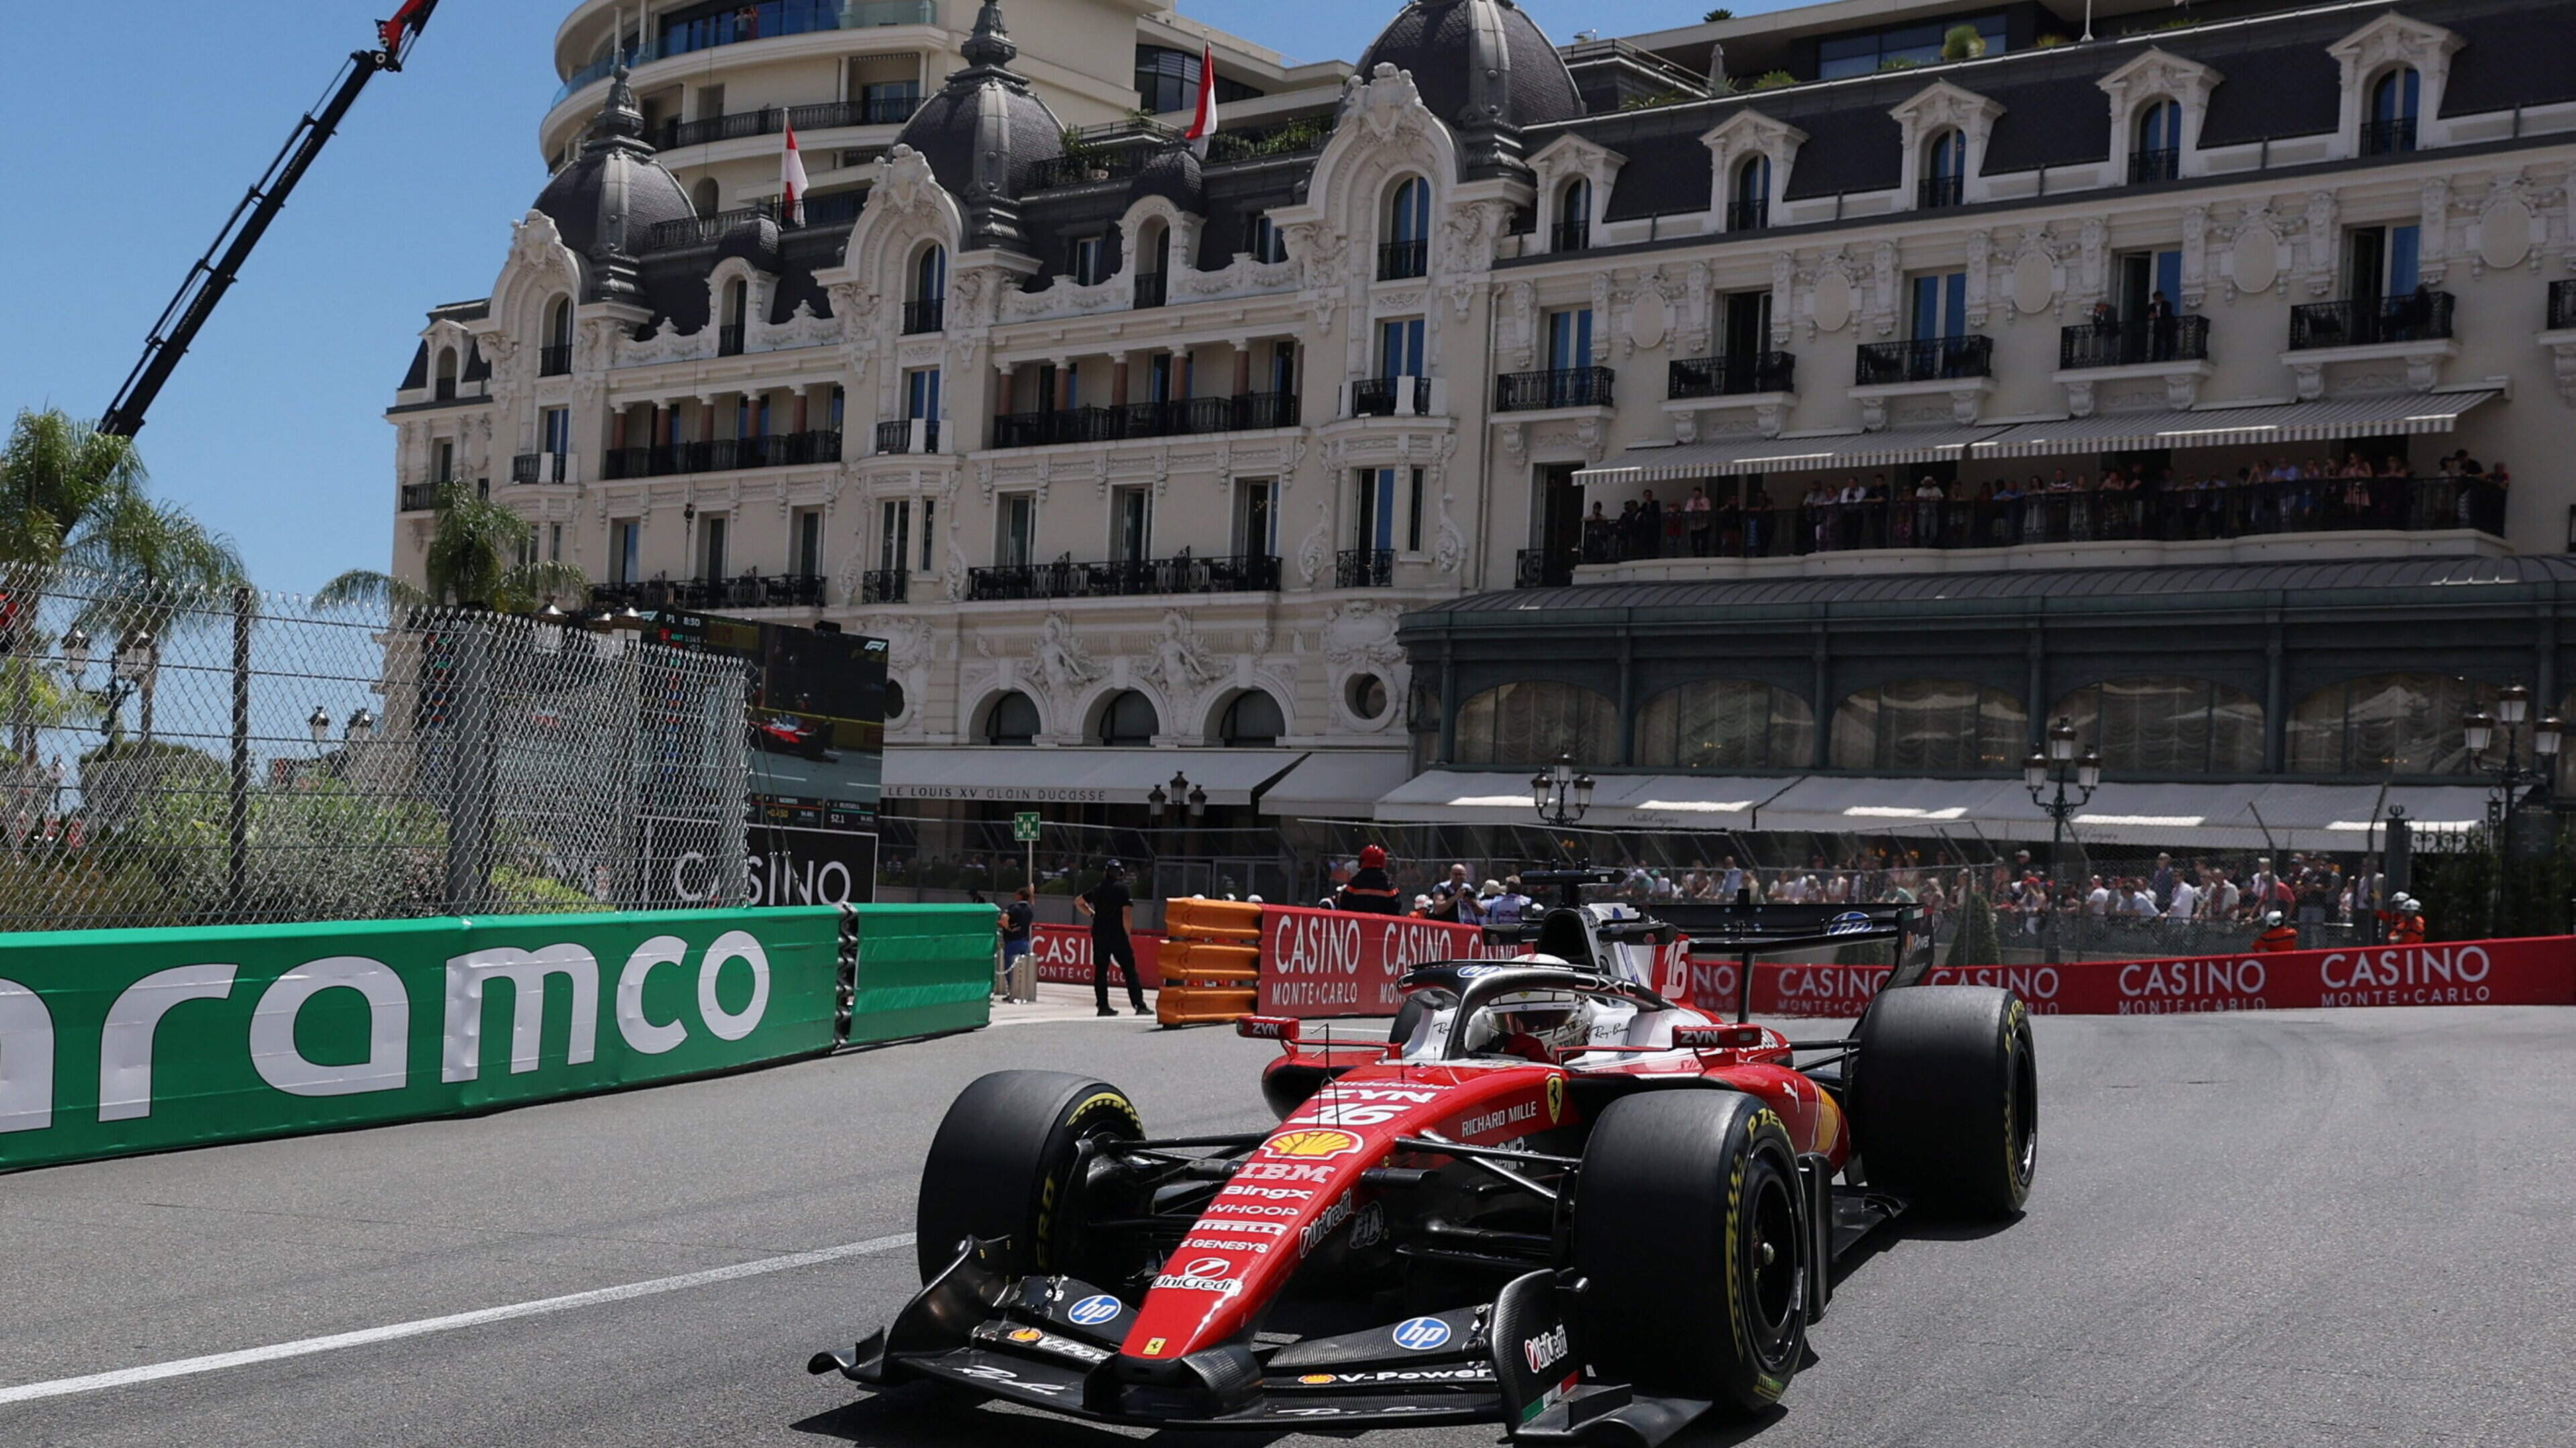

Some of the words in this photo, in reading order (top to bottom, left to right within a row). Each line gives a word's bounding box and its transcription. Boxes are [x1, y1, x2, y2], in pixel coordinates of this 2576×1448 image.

[888, 787, 903, 796] LE
[911, 787, 951, 797] LOUIS
[960, 789, 977, 797] XV
[1031, 936, 1121, 967] CASI
[1276, 914, 1360, 974] CASINO
[1383, 922, 1451, 975] CASINO
[1039, 966, 1073, 979] ONTE
[1662, 940, 1689, 999] 16
[2118, 960, 2265, 996] CASINO
[2321, 946, 2489, 989] CASINO
[1272, 983, 1313, 1005] MONTE
[1321, 982, 1358, 1004] CARLO
[1575, 974, 1637, 998] DXC
[2322, 990, 2397, 1007] MONTE
[2415, 986, 2489, 1003] CARLO
[1252, 1023, 1279, 1036] ZYN
[1680, 1031, 1718, 1044] ZYN
[1309, 1089, 1437, 1103] ZYN
[1287, 1103, 1412, 1125] 16
[1462, 1110, 1506, 1137] RICHARD
[1509, 1101, 1537, 1123] MILLE
[1234, 1163, 1336, 1184] IBM
[1208, 1205, 1299, 1216] WHOOP
[1191, 1219, 1287, 1236] PIRELLI
[1192, 1239, 1269, 1254] GENESYS
[1152, 1275, 1236, 1291] UniCredi
[1072, 1295, 1118, 1325] hp
[1397, 1317, 1447, 1349] hp
[1338, 1369, 1492, 1382] V-Power
